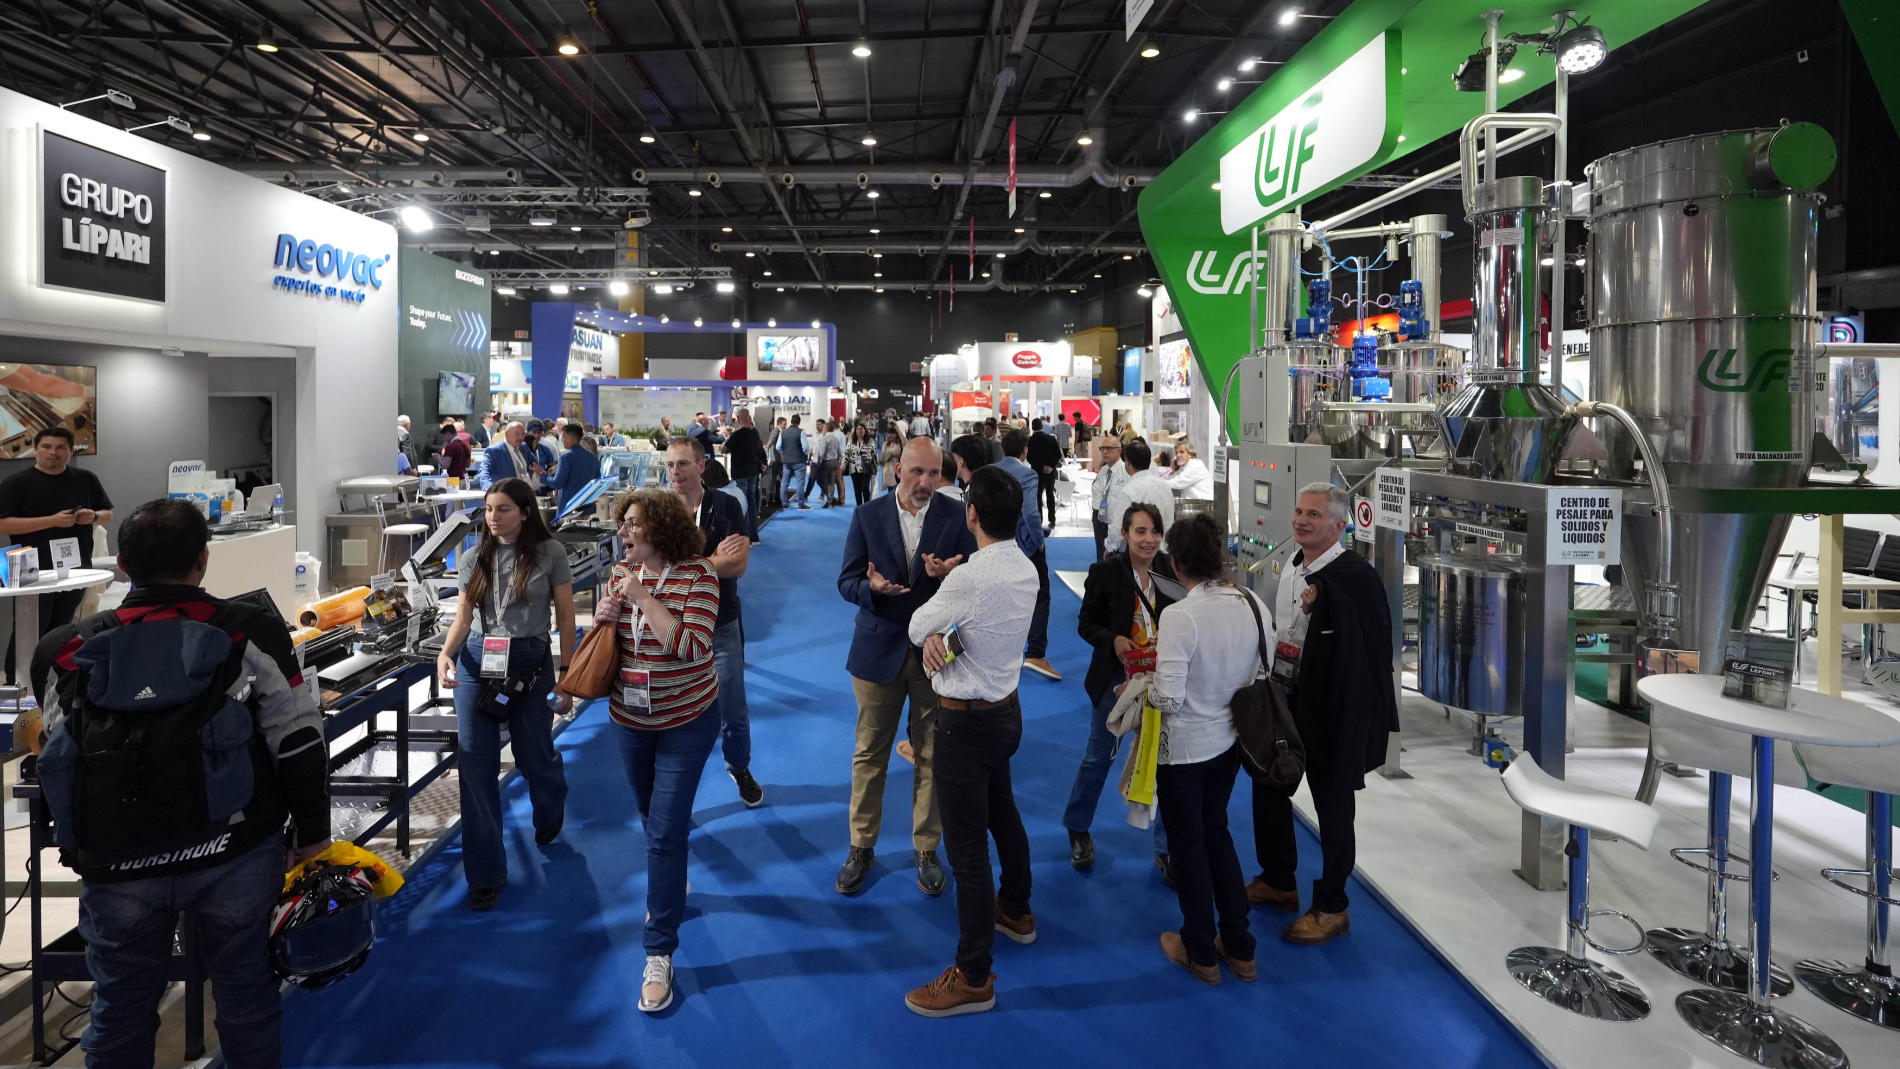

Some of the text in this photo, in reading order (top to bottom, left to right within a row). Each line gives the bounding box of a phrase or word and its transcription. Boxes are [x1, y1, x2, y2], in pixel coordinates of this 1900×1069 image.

[60, 172, 153, 225] GRUPO
[62, 216, 151, 265] LÍPARI
[274, 233, 386, 288] neovac
[273, 275, 323, 293] expertos
[324, 286, 337, 297] en
[409, 305, 425, 317] Shape
[425, 310, 437, 319] your
[409, 316, 427, 330] Today.
[1735, 452, 1757, 460] TOLVA
[1757, 452, 1783, 460] BALANZA
[1380, 475, 1405, 486] CENTRO DE
[1379, 484, 1406, 495] PESAJE PARA
[1381, 493, 1400, 504] SOLIDOS
[1560, 497, 1610, 508] CENTRO DE
[1556, 509, 1614, 520] PESAJE PARA
[1561, 521, 1608, 532] SOLIDOS Y
[1562, 532, 1606, 544] LIQUIDOS
[1749, 668, 1777, 677] LEFONT
